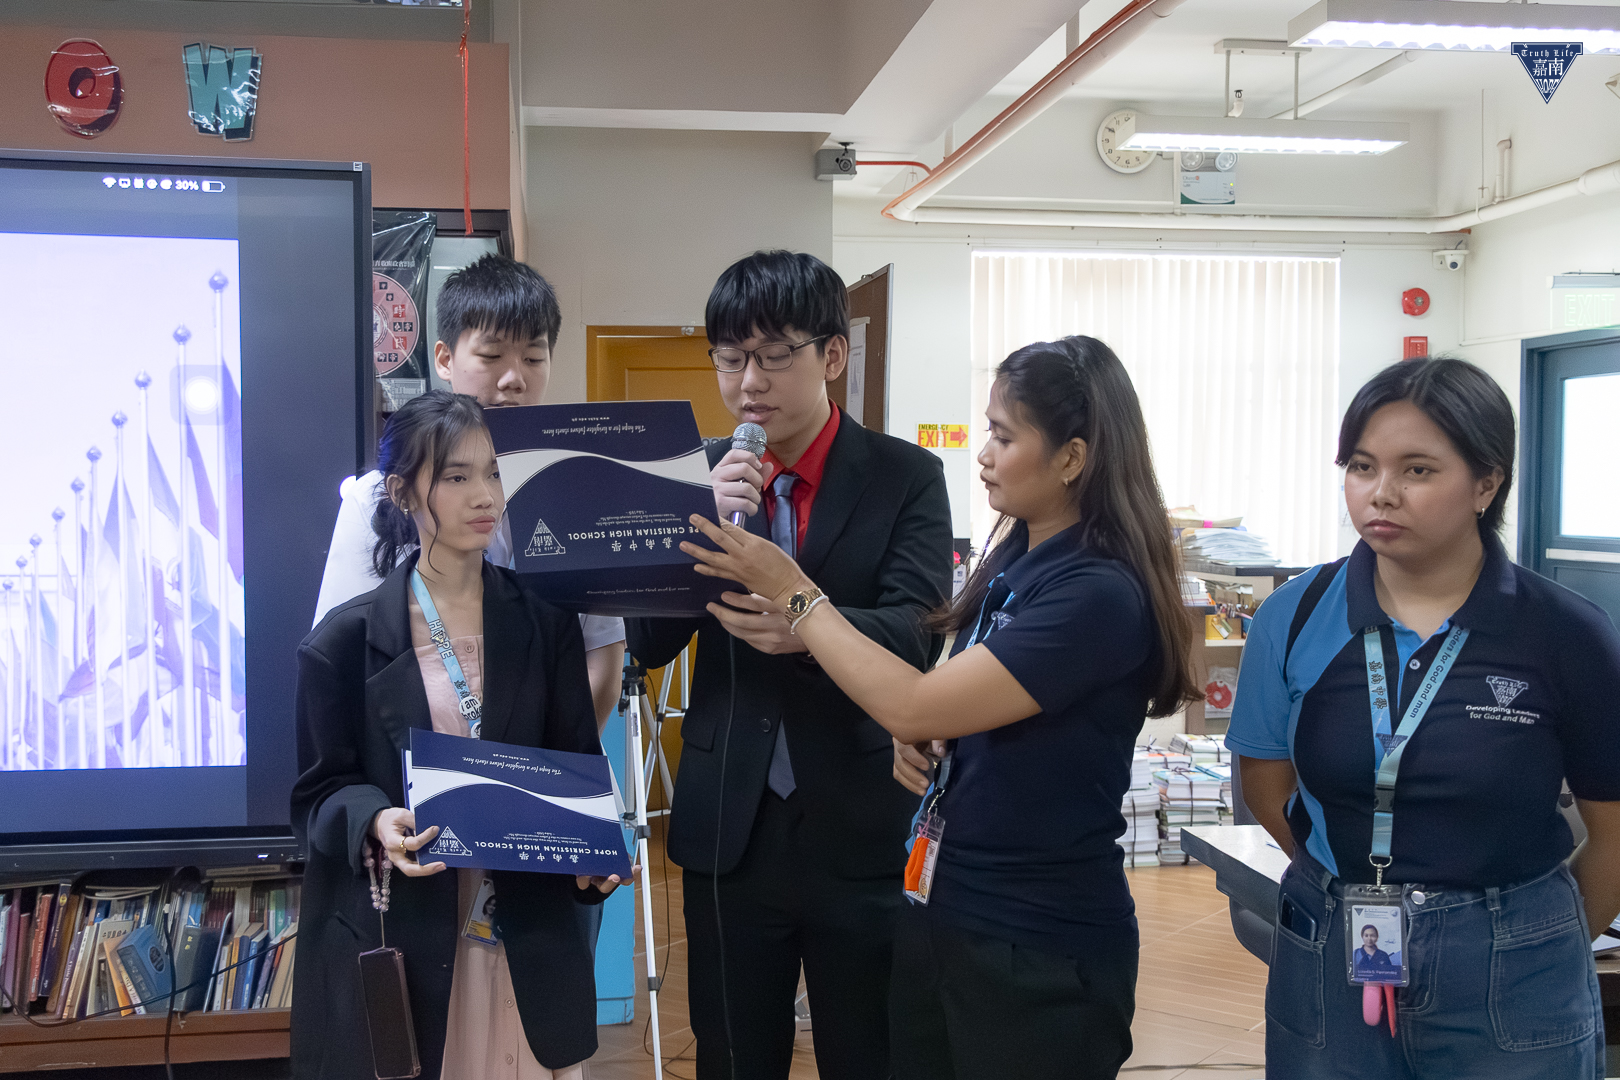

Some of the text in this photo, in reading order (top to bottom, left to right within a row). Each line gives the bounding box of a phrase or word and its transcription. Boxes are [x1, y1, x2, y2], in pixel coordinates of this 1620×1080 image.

[175, 179, 199, 190] 30%
[1564, 294, 1616, 327] EXIT
[570, 426, 586, 435] future
[586, 424, 608, 435] brighter
[613, 424, 621, 434] for
[622, 423, 634, 433] hope
[635, 424, 646, 433] The
[918, 430, 949, 447] EXIT
[568, 531, 606, 540] SCHOOL
[609, 529, 632, 538] HIGH
[636, 526, 685, 536] CHRISTIAN
[1440, 652, 1452, 664] for
[1430, 665, 1444, 684] God
[1420, 682, 1433, 701] and
[464, 698, 478, 709] am
[1410, 701, 1423, 718] man
[1466, 705, 1540, 719] Developing Leaders
[1484, 712, 1500, 720] God
[1519, 716, 1534, 725] Man
[490, 760, 505, 768] future
[505, 762, 526, 771] brighter
[539, 765, 551, 774] hope
[475, 841, 513, 849] SCHOOL
[544, 845, 591, 854] CHRISTIAN
